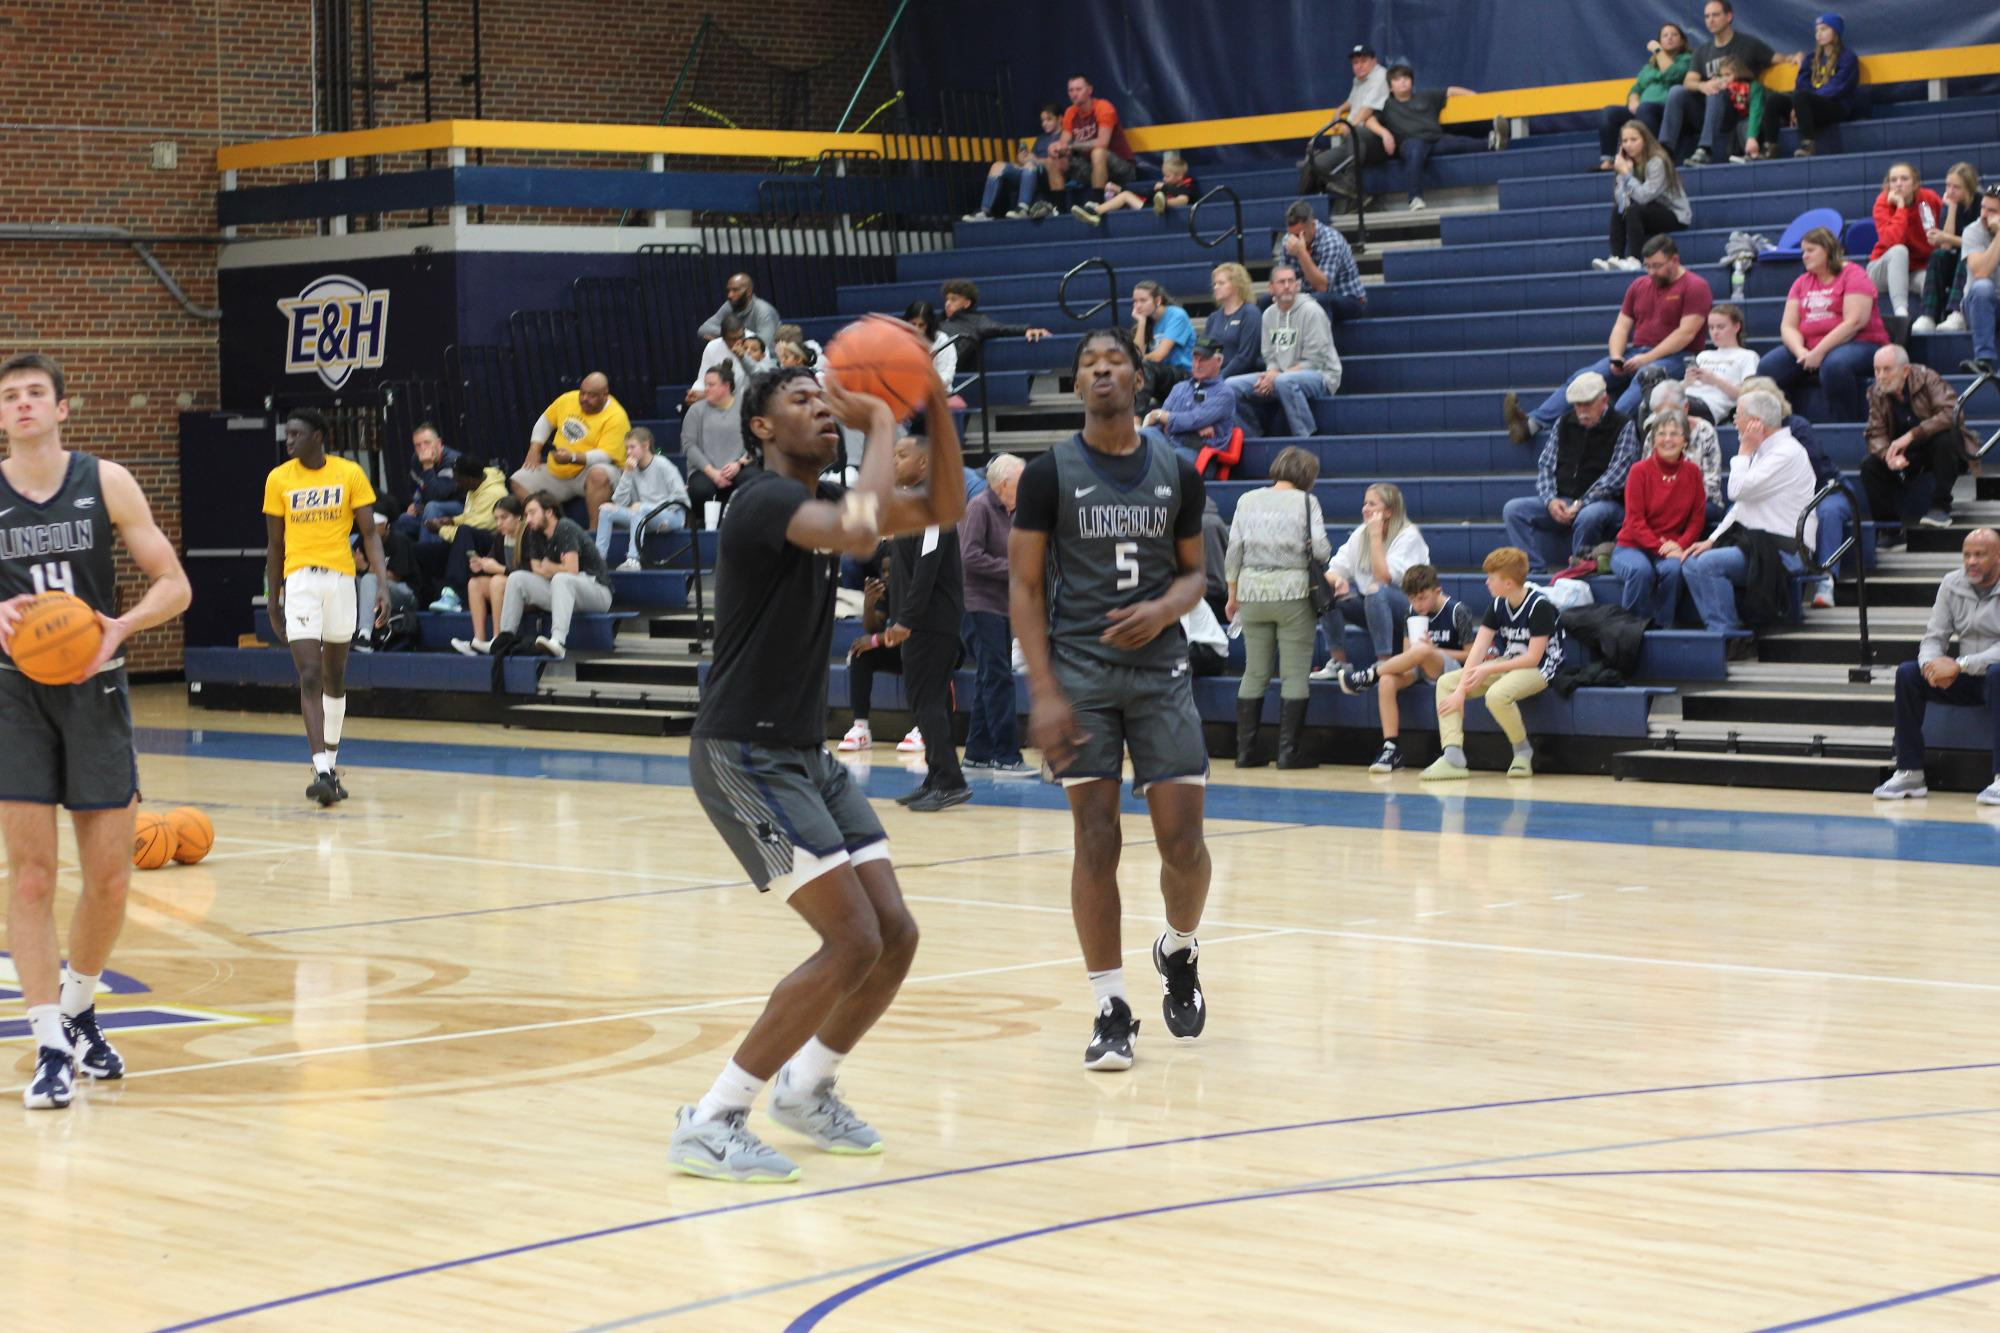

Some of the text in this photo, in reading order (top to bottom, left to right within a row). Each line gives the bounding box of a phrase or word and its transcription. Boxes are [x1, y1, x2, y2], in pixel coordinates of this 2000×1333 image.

[285, 295, 386, 368] E&H
[291, 487, 342, 509] E&H
[0, 519, 94, 559] LINCOLN
[1079, 505, 1167, 538] LINCOLN
[30, 561, 75, 595] 14
[1115, 542, 1139, 590] 5
